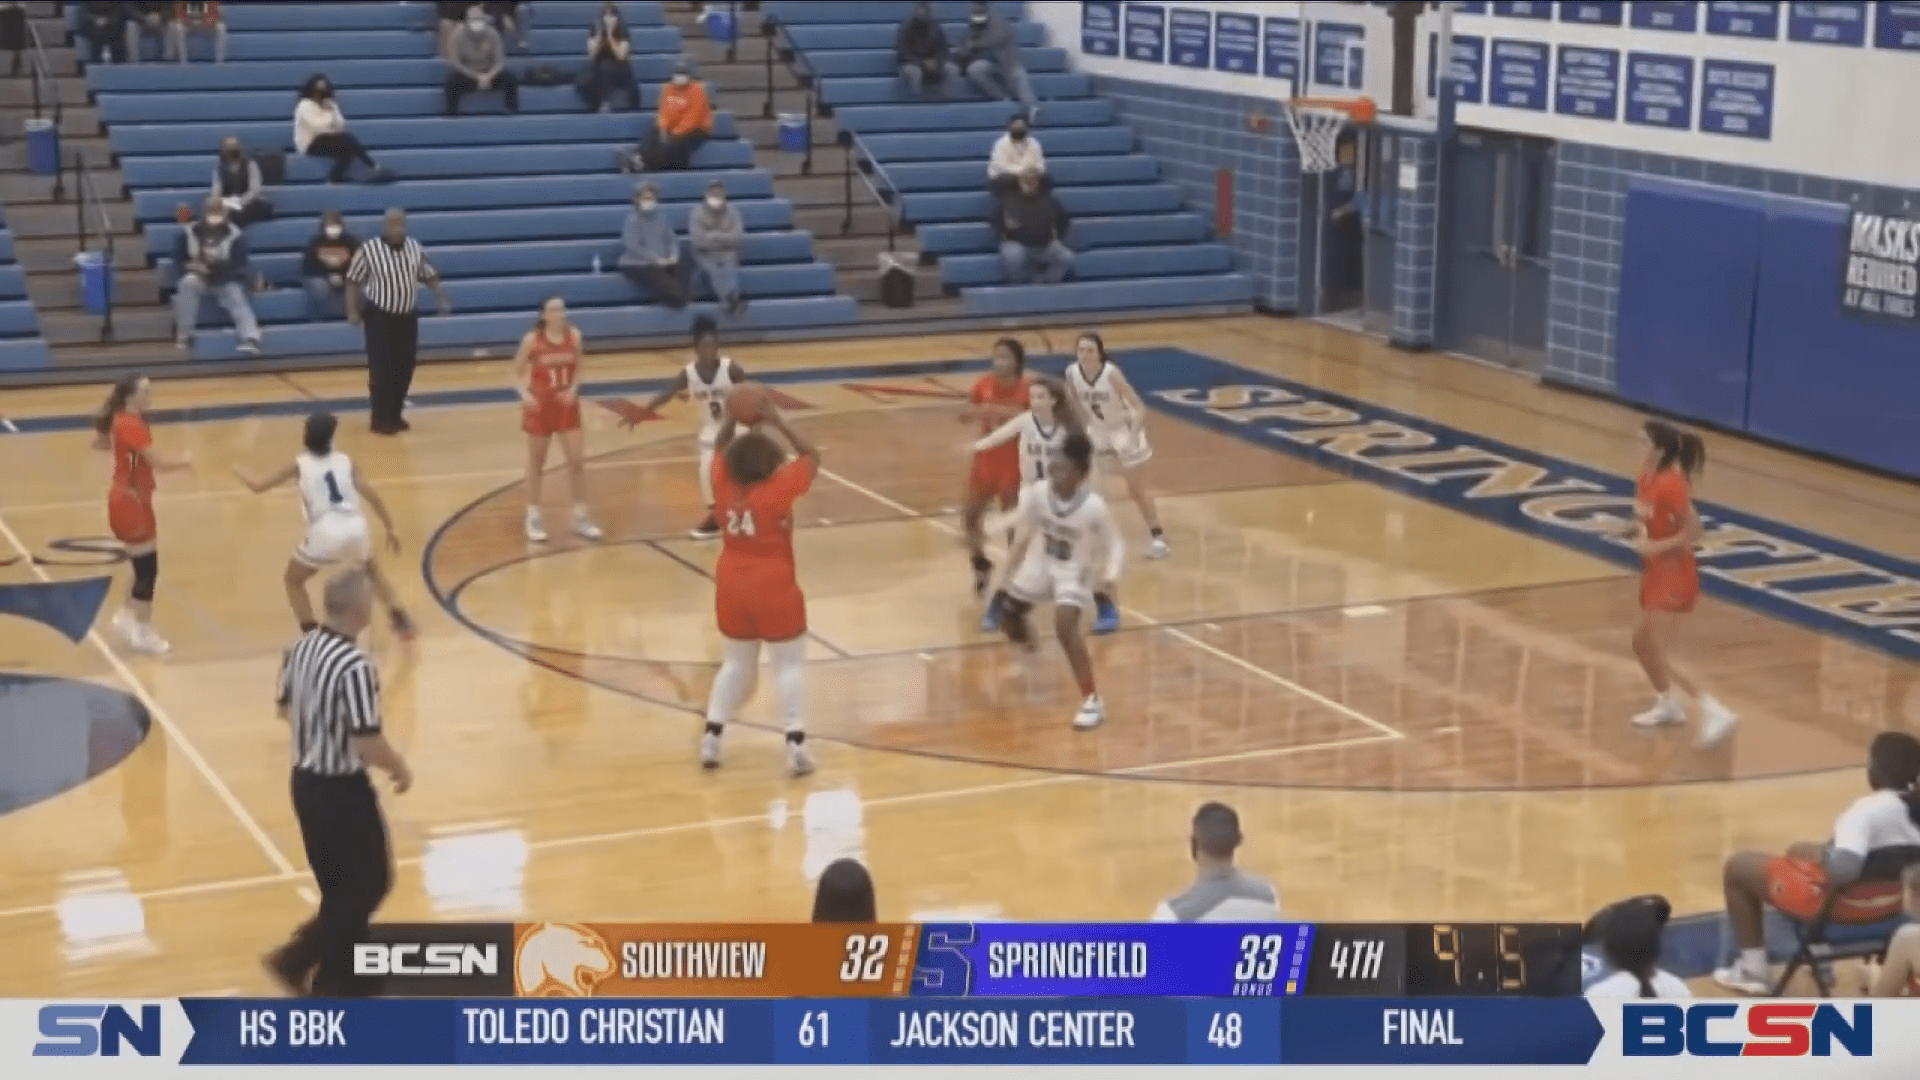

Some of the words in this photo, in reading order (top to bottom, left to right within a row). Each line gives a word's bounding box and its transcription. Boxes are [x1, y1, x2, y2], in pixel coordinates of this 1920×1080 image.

[1850, 212, 1920, 263] MASKS
[323, 469, 344, 504] 1
[726, 509, 756, 536] 24
